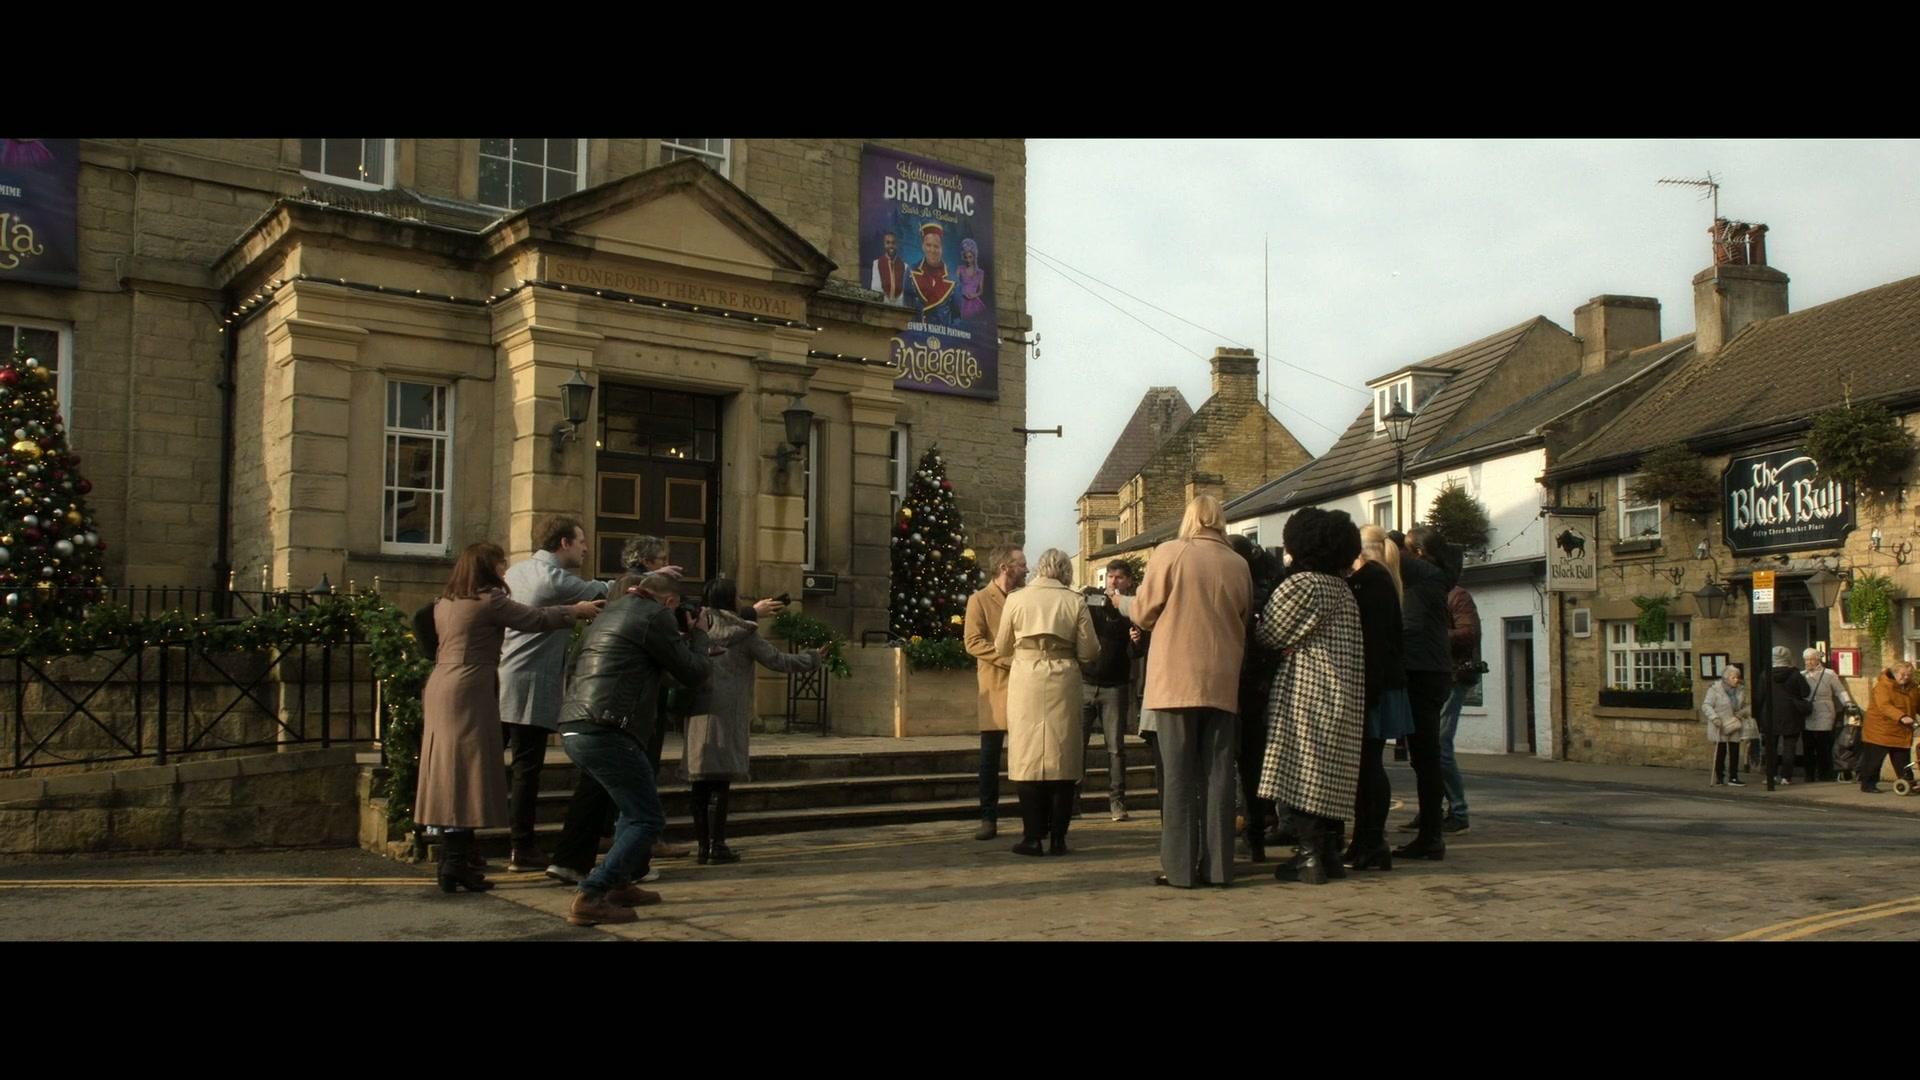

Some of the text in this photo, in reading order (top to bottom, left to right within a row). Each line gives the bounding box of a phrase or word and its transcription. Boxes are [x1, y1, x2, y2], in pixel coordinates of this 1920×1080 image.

[896, 161, 962, 190] Hollywood's
[884, 175, 933, 206] BRAD
[937, 187, 975, 216] MAC
[556, 263, 792, 315] STONEFORD THEATRE ROYAL
[1731, 478, 1843, 530] Black Bull
[1786, 525, 1807, 534] Market
[1552, 564, 1593, 579] Black Bull
